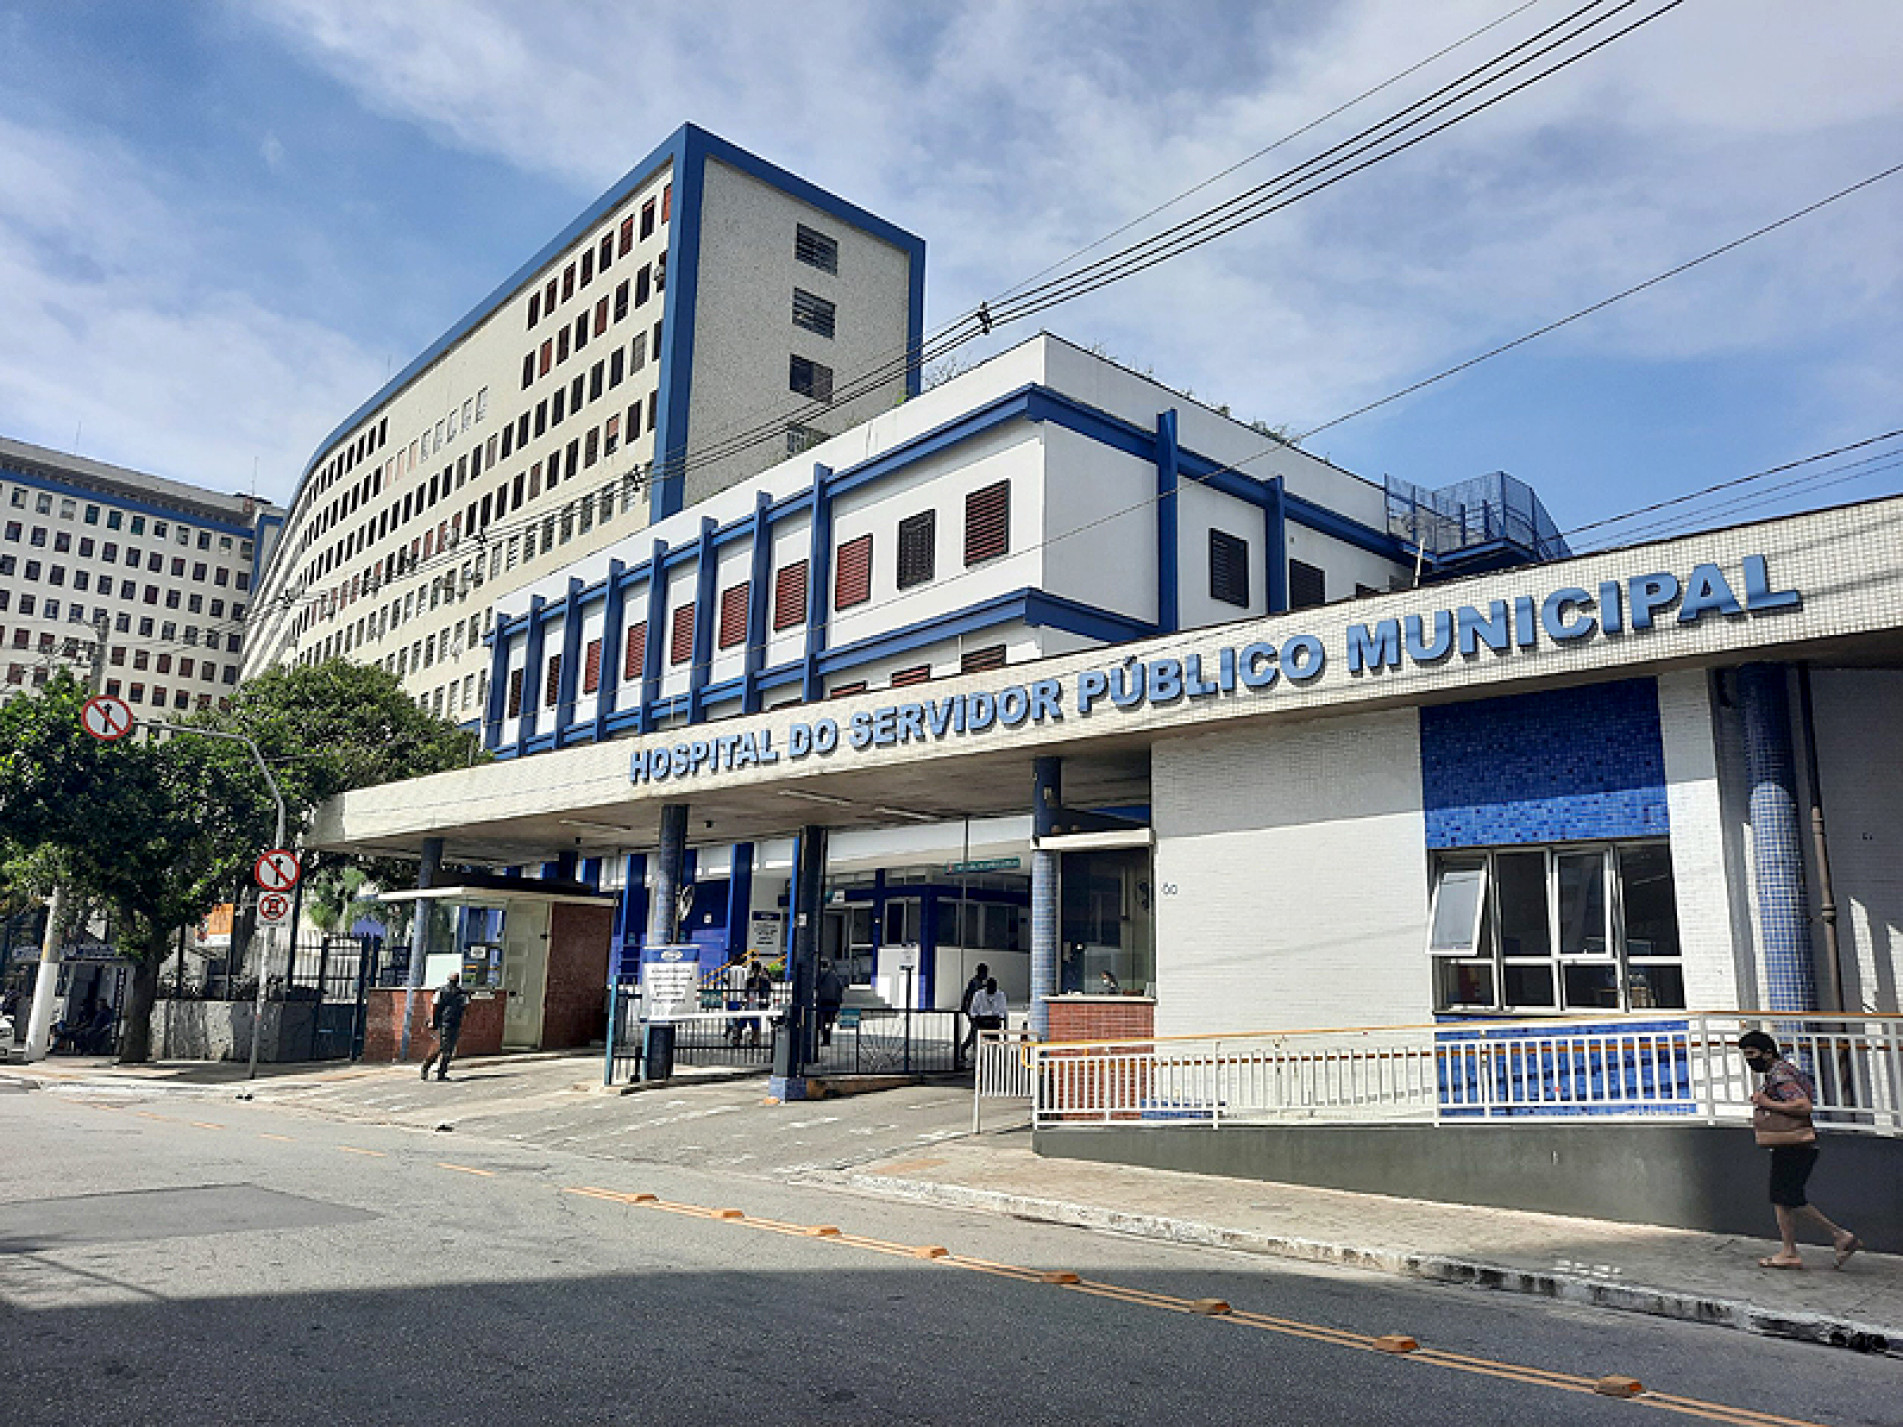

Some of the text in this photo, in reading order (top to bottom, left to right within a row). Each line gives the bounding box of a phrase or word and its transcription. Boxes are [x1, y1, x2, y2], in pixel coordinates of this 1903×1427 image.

[630, 554, 1801, 784] HOSPITAL DO SERVIDOR PÚBLICO MUNICIPAL
